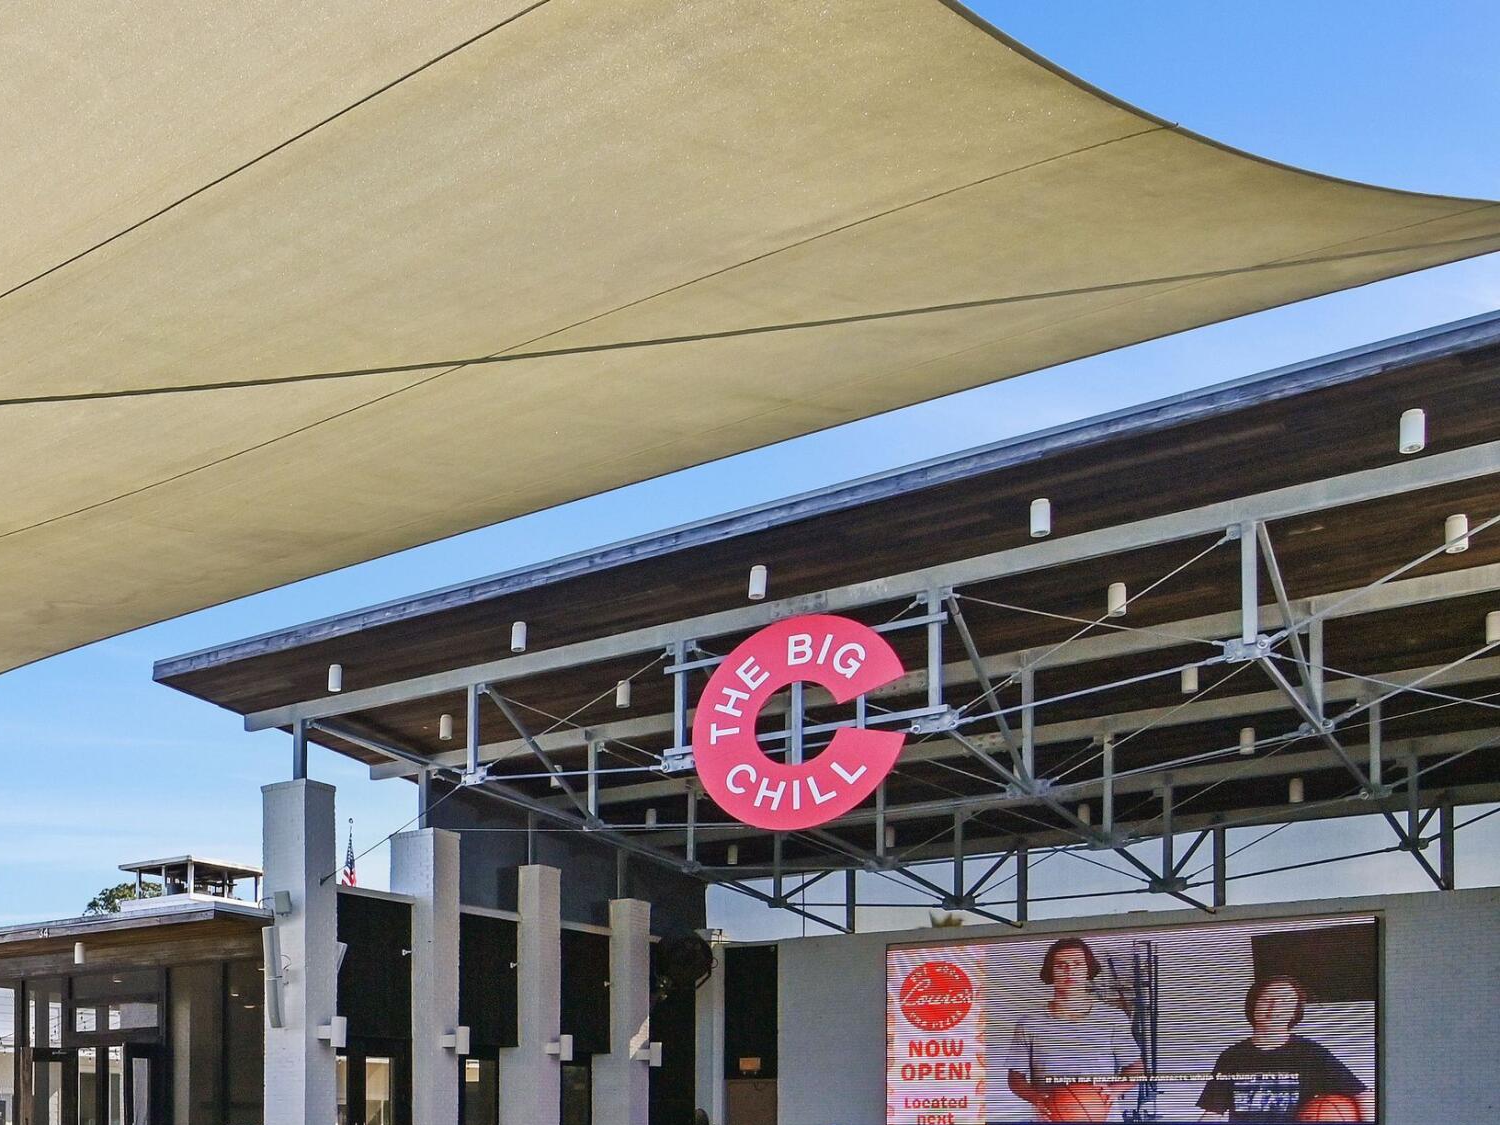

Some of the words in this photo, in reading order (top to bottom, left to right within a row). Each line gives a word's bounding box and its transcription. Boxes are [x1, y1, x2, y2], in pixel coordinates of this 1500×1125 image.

[710, 656, 770, 745] THE
[787, 633, 866, 679] BIG
[726, 763, 867, 811] CHILL
[908, 1040, 964, 1057] NOW
[901, 1062, 972, 1080] OPEN!
[904, 1096, 967, 1109] Located
[917, 1113, 954, 1125] next
